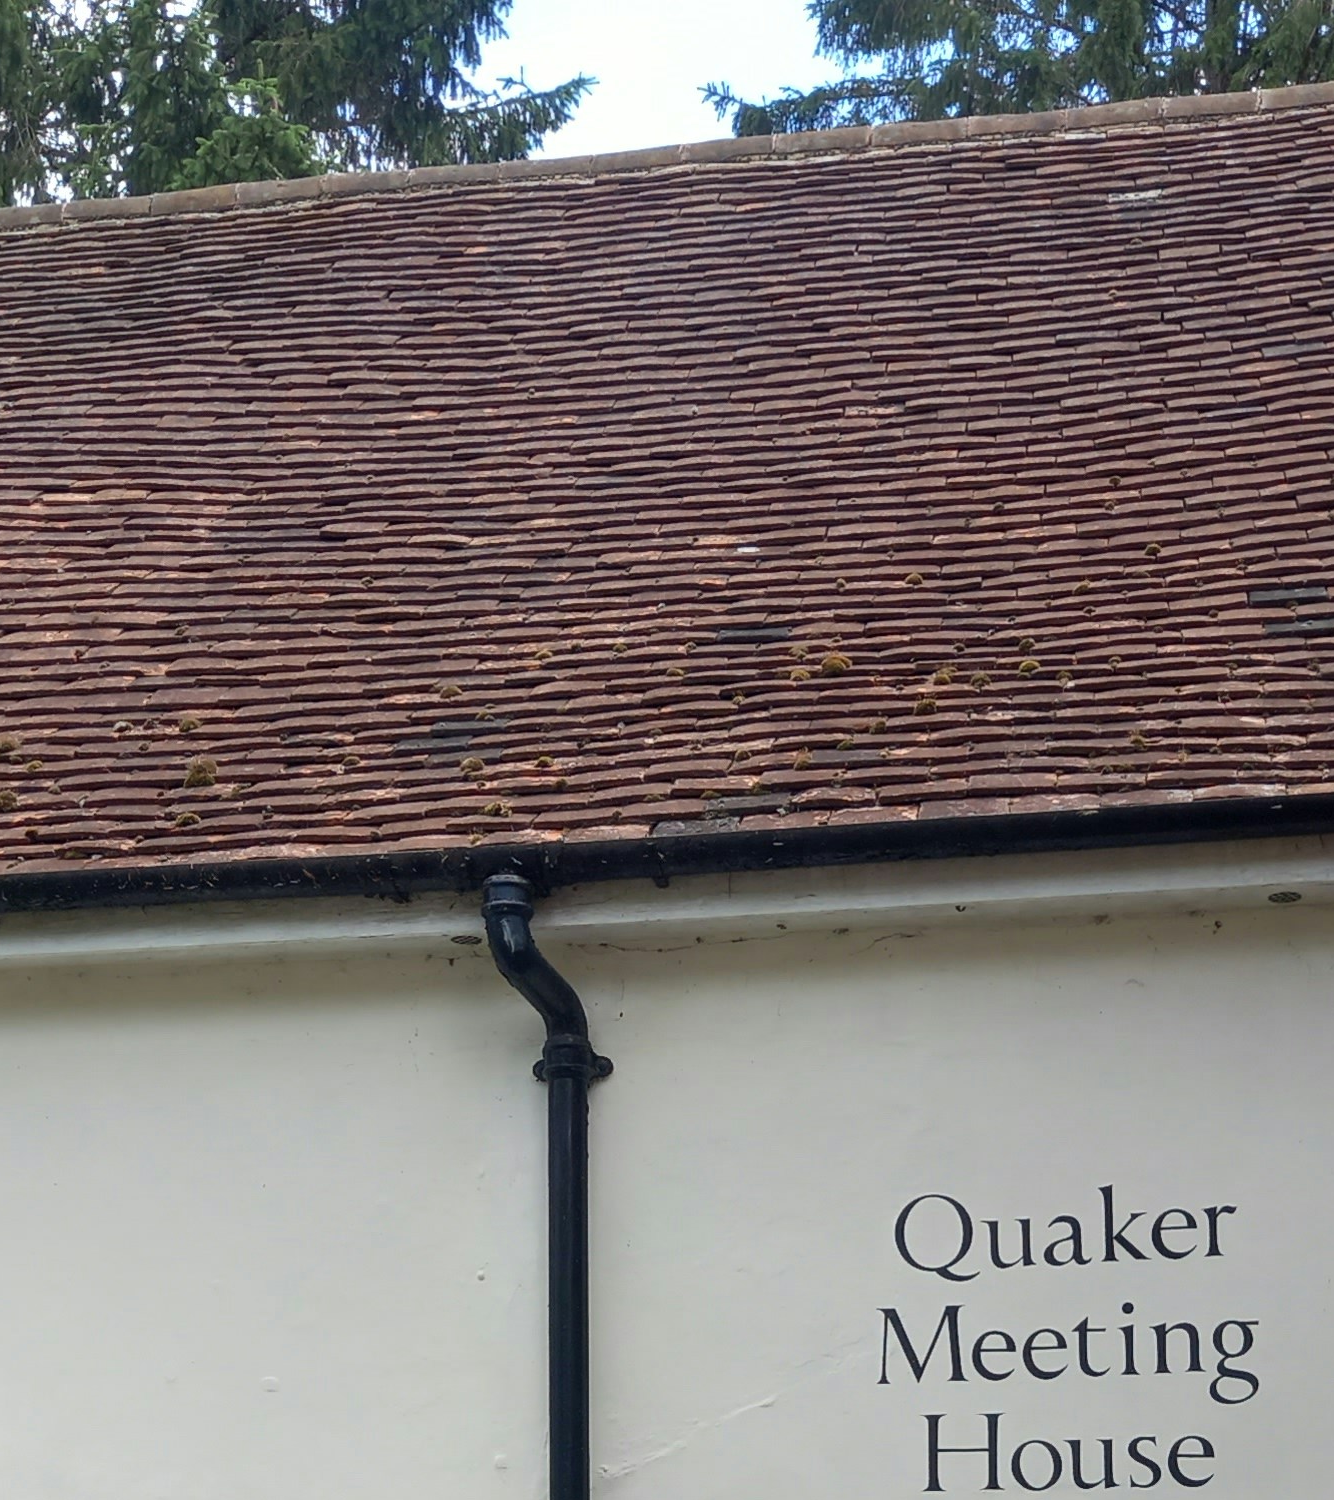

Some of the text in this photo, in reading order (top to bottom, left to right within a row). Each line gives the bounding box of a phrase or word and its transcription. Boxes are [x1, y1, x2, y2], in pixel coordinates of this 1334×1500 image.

[894, 1184, 1237, 1282] Quaker
[876, 1302, 1259, 1405] Meeting
[920, 1412, 1216, 1492] House
